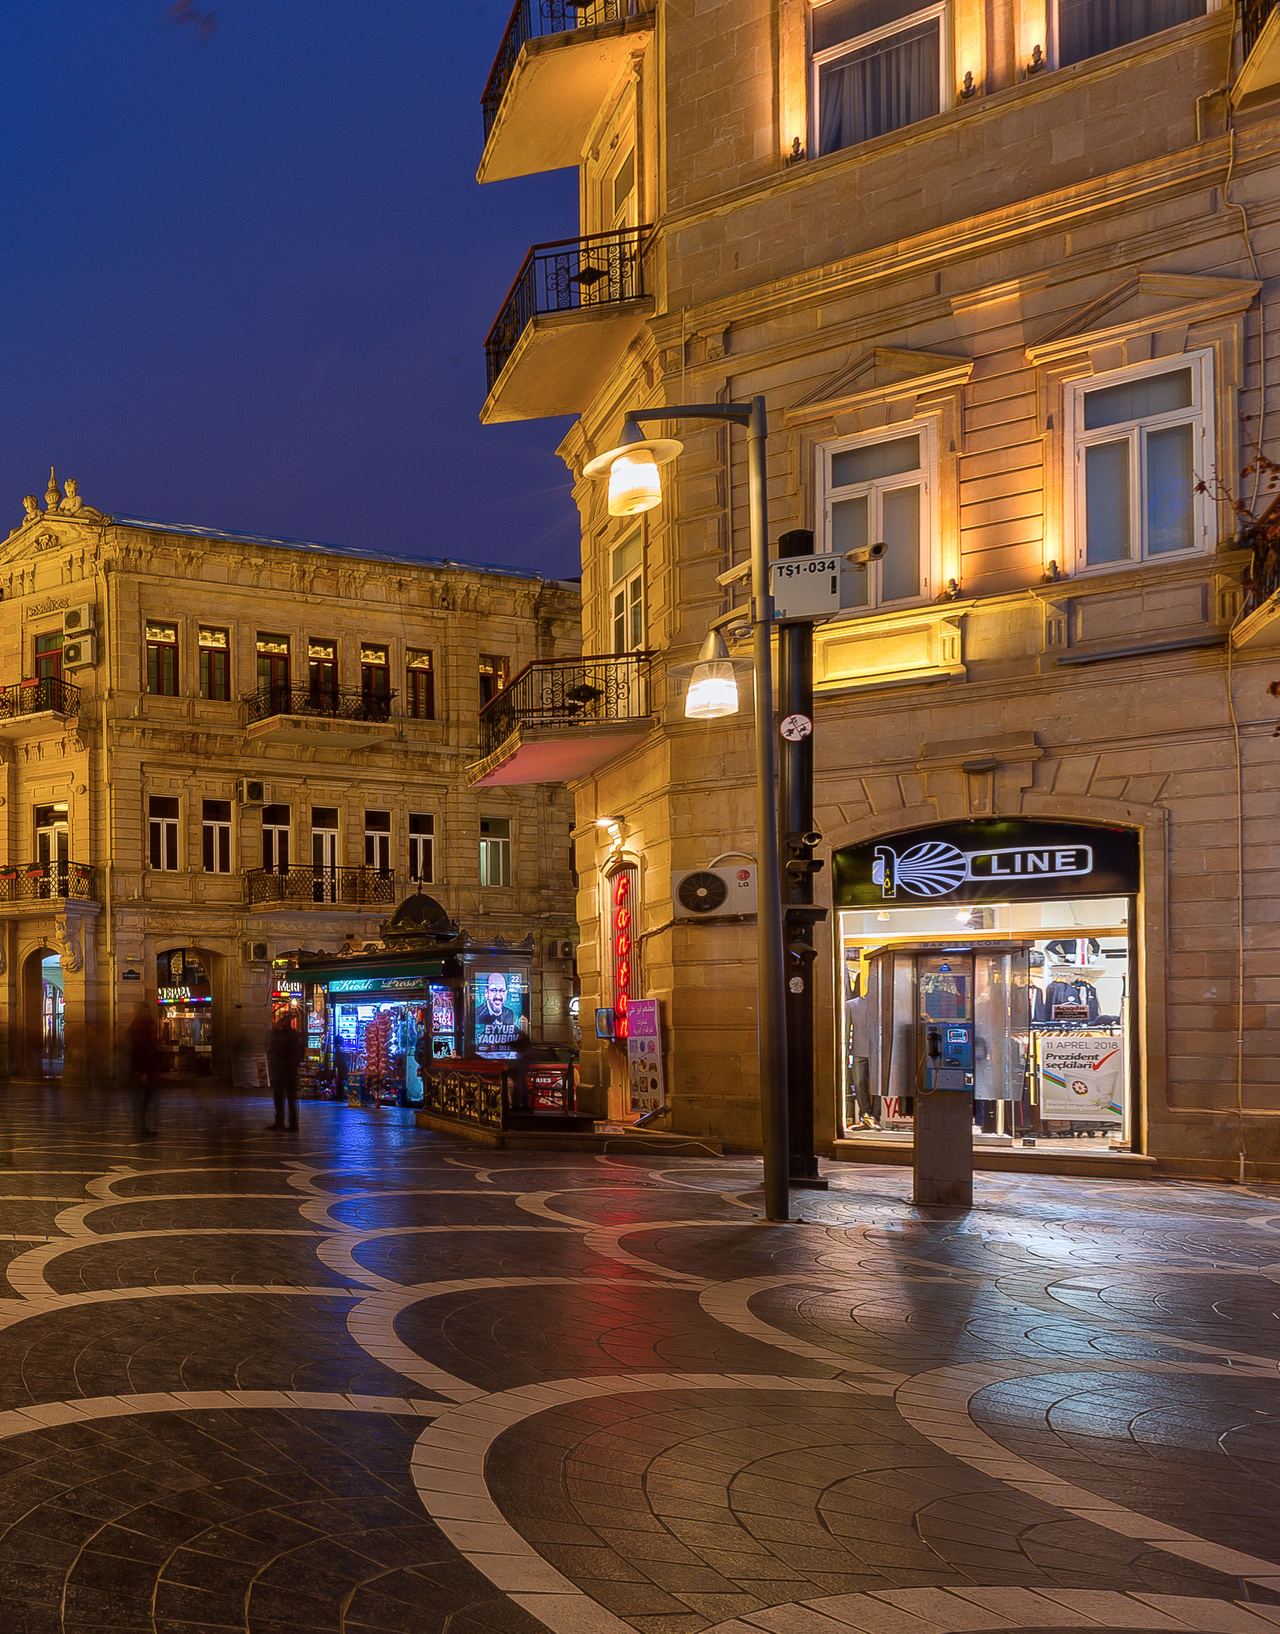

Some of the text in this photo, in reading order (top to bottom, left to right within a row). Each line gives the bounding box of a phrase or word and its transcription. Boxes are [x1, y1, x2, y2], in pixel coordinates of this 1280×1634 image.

[777, 560, 836, 578] TŞ1-034
[991, 850, 1077, 874] LINE
[923, 940, 1000, 948] BAKTELECOM
[336, 979, 374, 991] Kiosk
[485, 1025, 514, 1034] EYYUB
[477, 1034, 519, 1044] YAQUBOV
[1045, 1053, 1100, 1061] Prezident
[1045, 1061, 1093, 1070] seçkiləri
